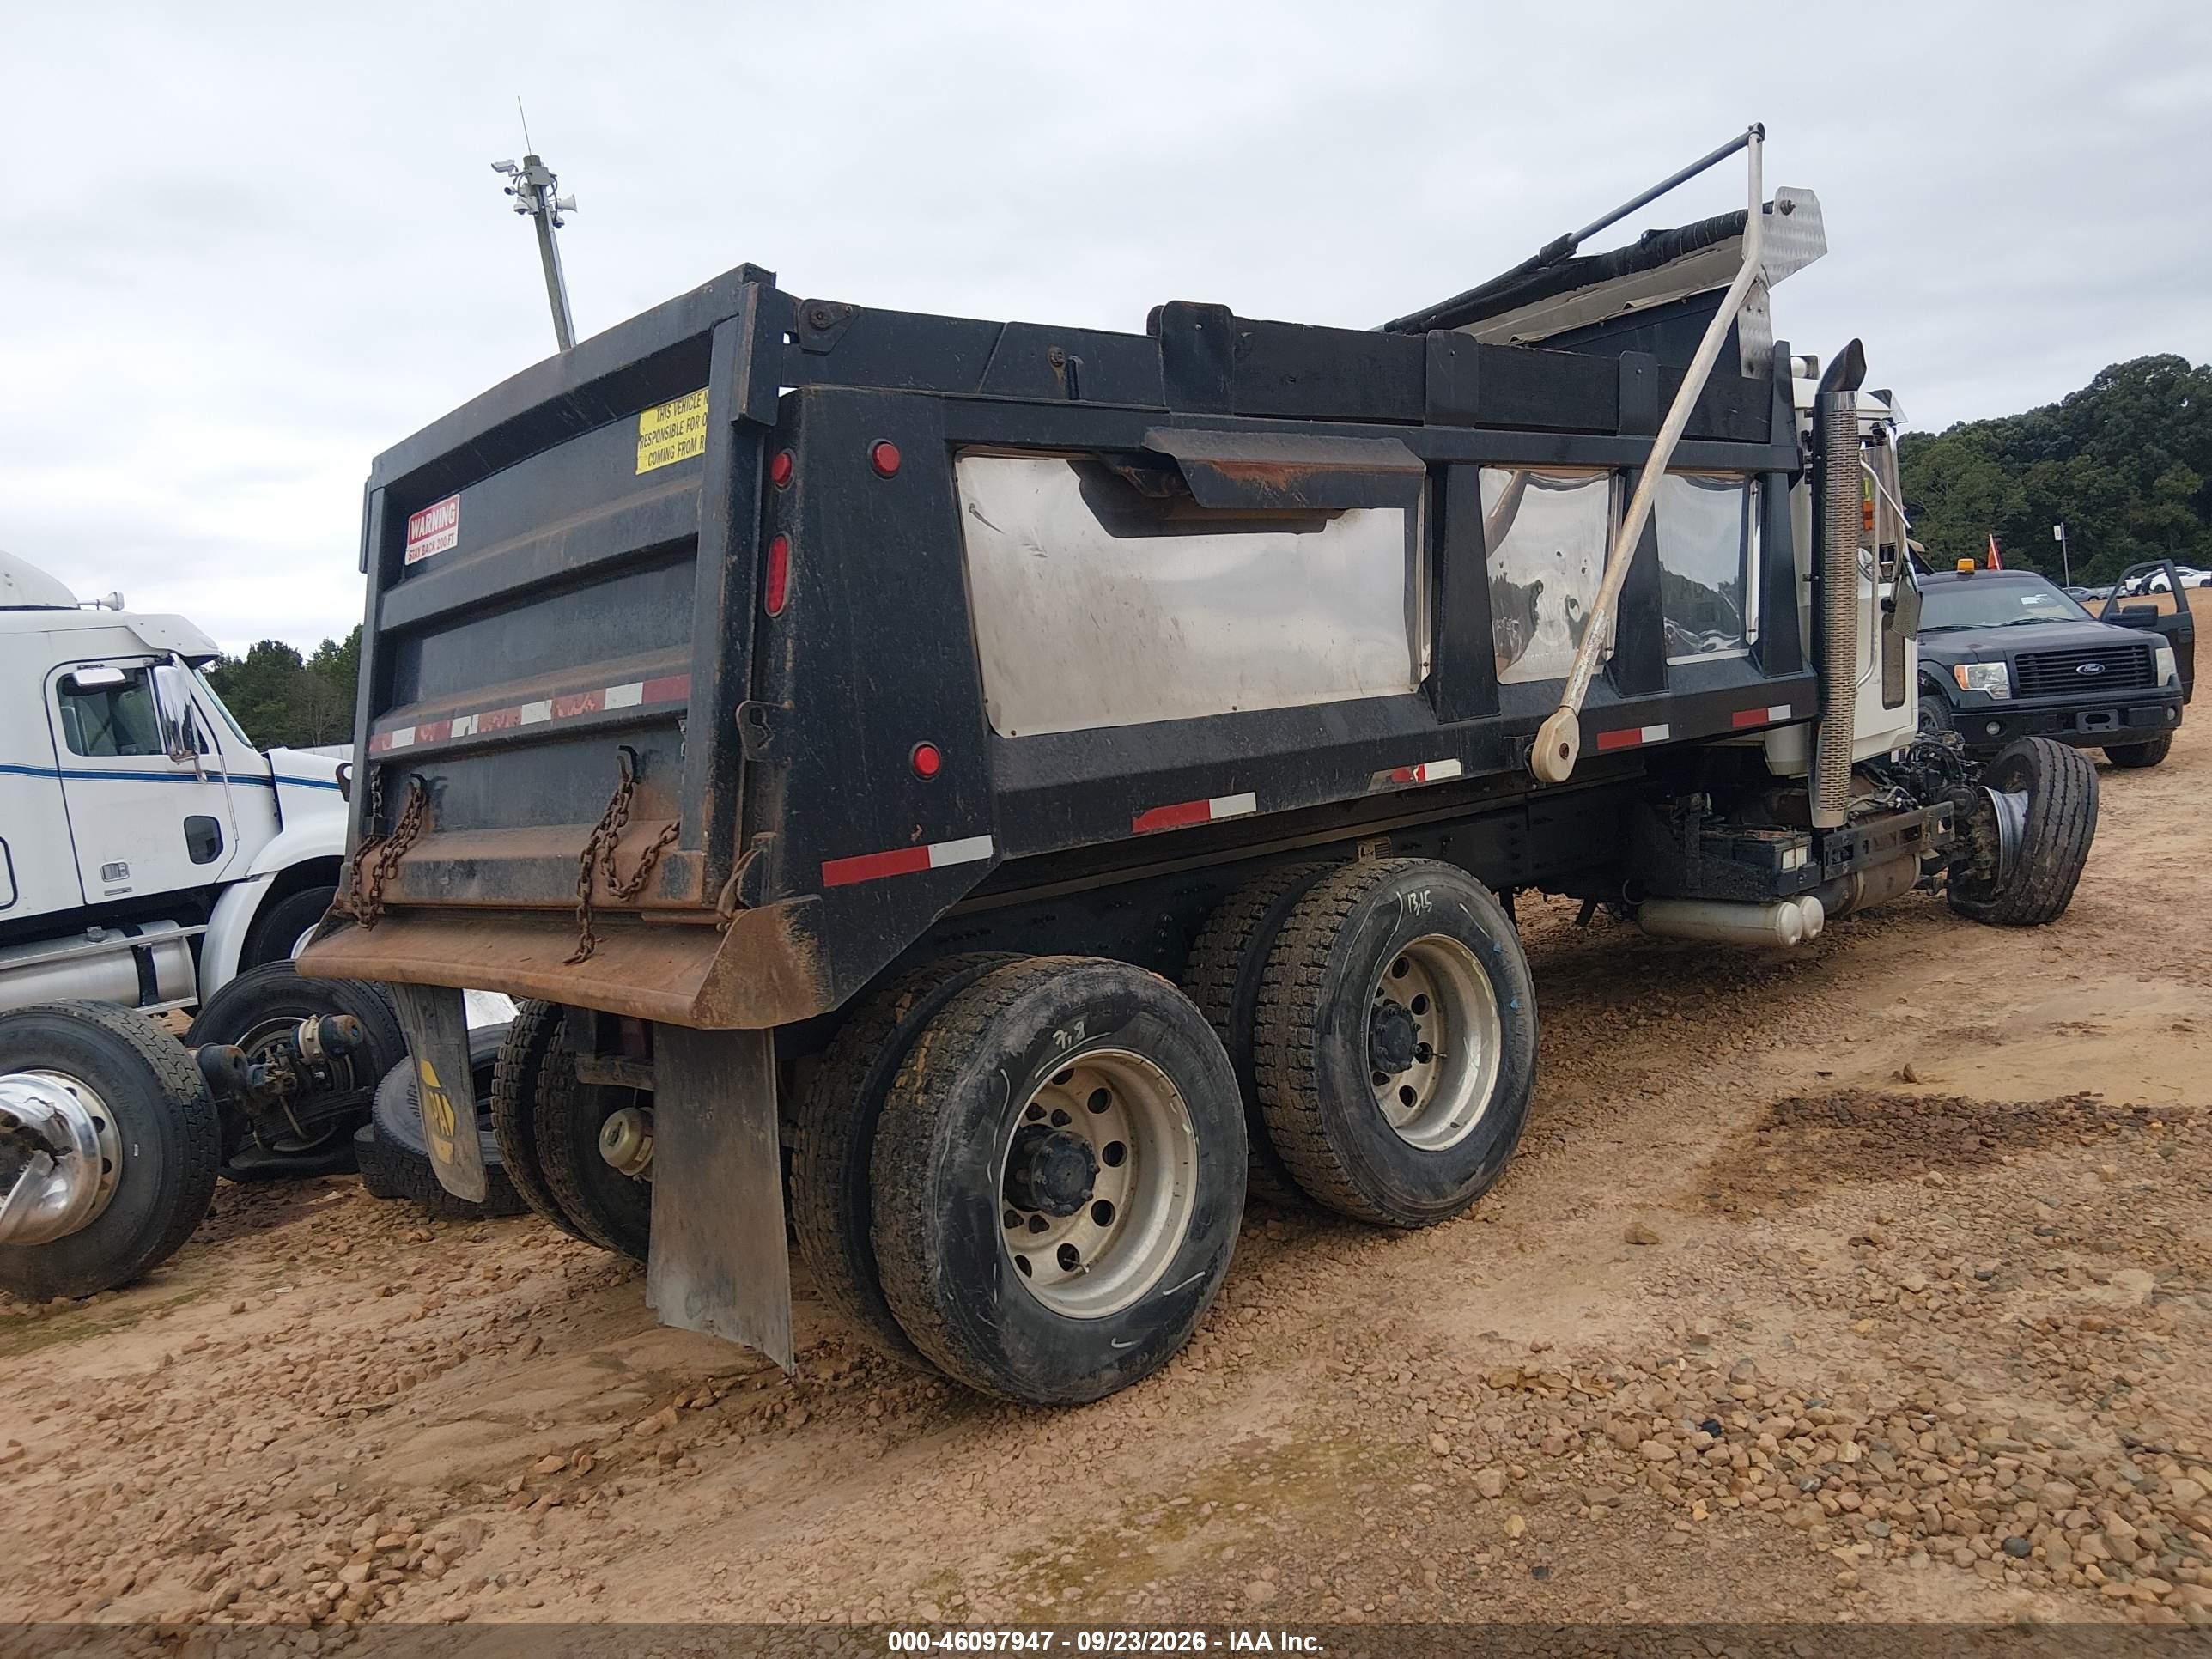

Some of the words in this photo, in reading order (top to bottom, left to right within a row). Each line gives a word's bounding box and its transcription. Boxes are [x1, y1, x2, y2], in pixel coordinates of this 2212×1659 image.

[657, 404, 672, 422] THIS
[673, 392, 702, 416] VEHICLE
[640, 420, 684, 449] RESPONSIBLE
[686, 414, 700, 433] FOR
[647, 444, 675, 467] COMING
[678, 436, 697, 458] FROM
[412, 503, 455, 540] WARNING
[408, 546, 422, 561] STAY
[422, 541, 436, 556] BACK
[436, 536, 447, 550] 200
[447, 532, 454, 546] FT
